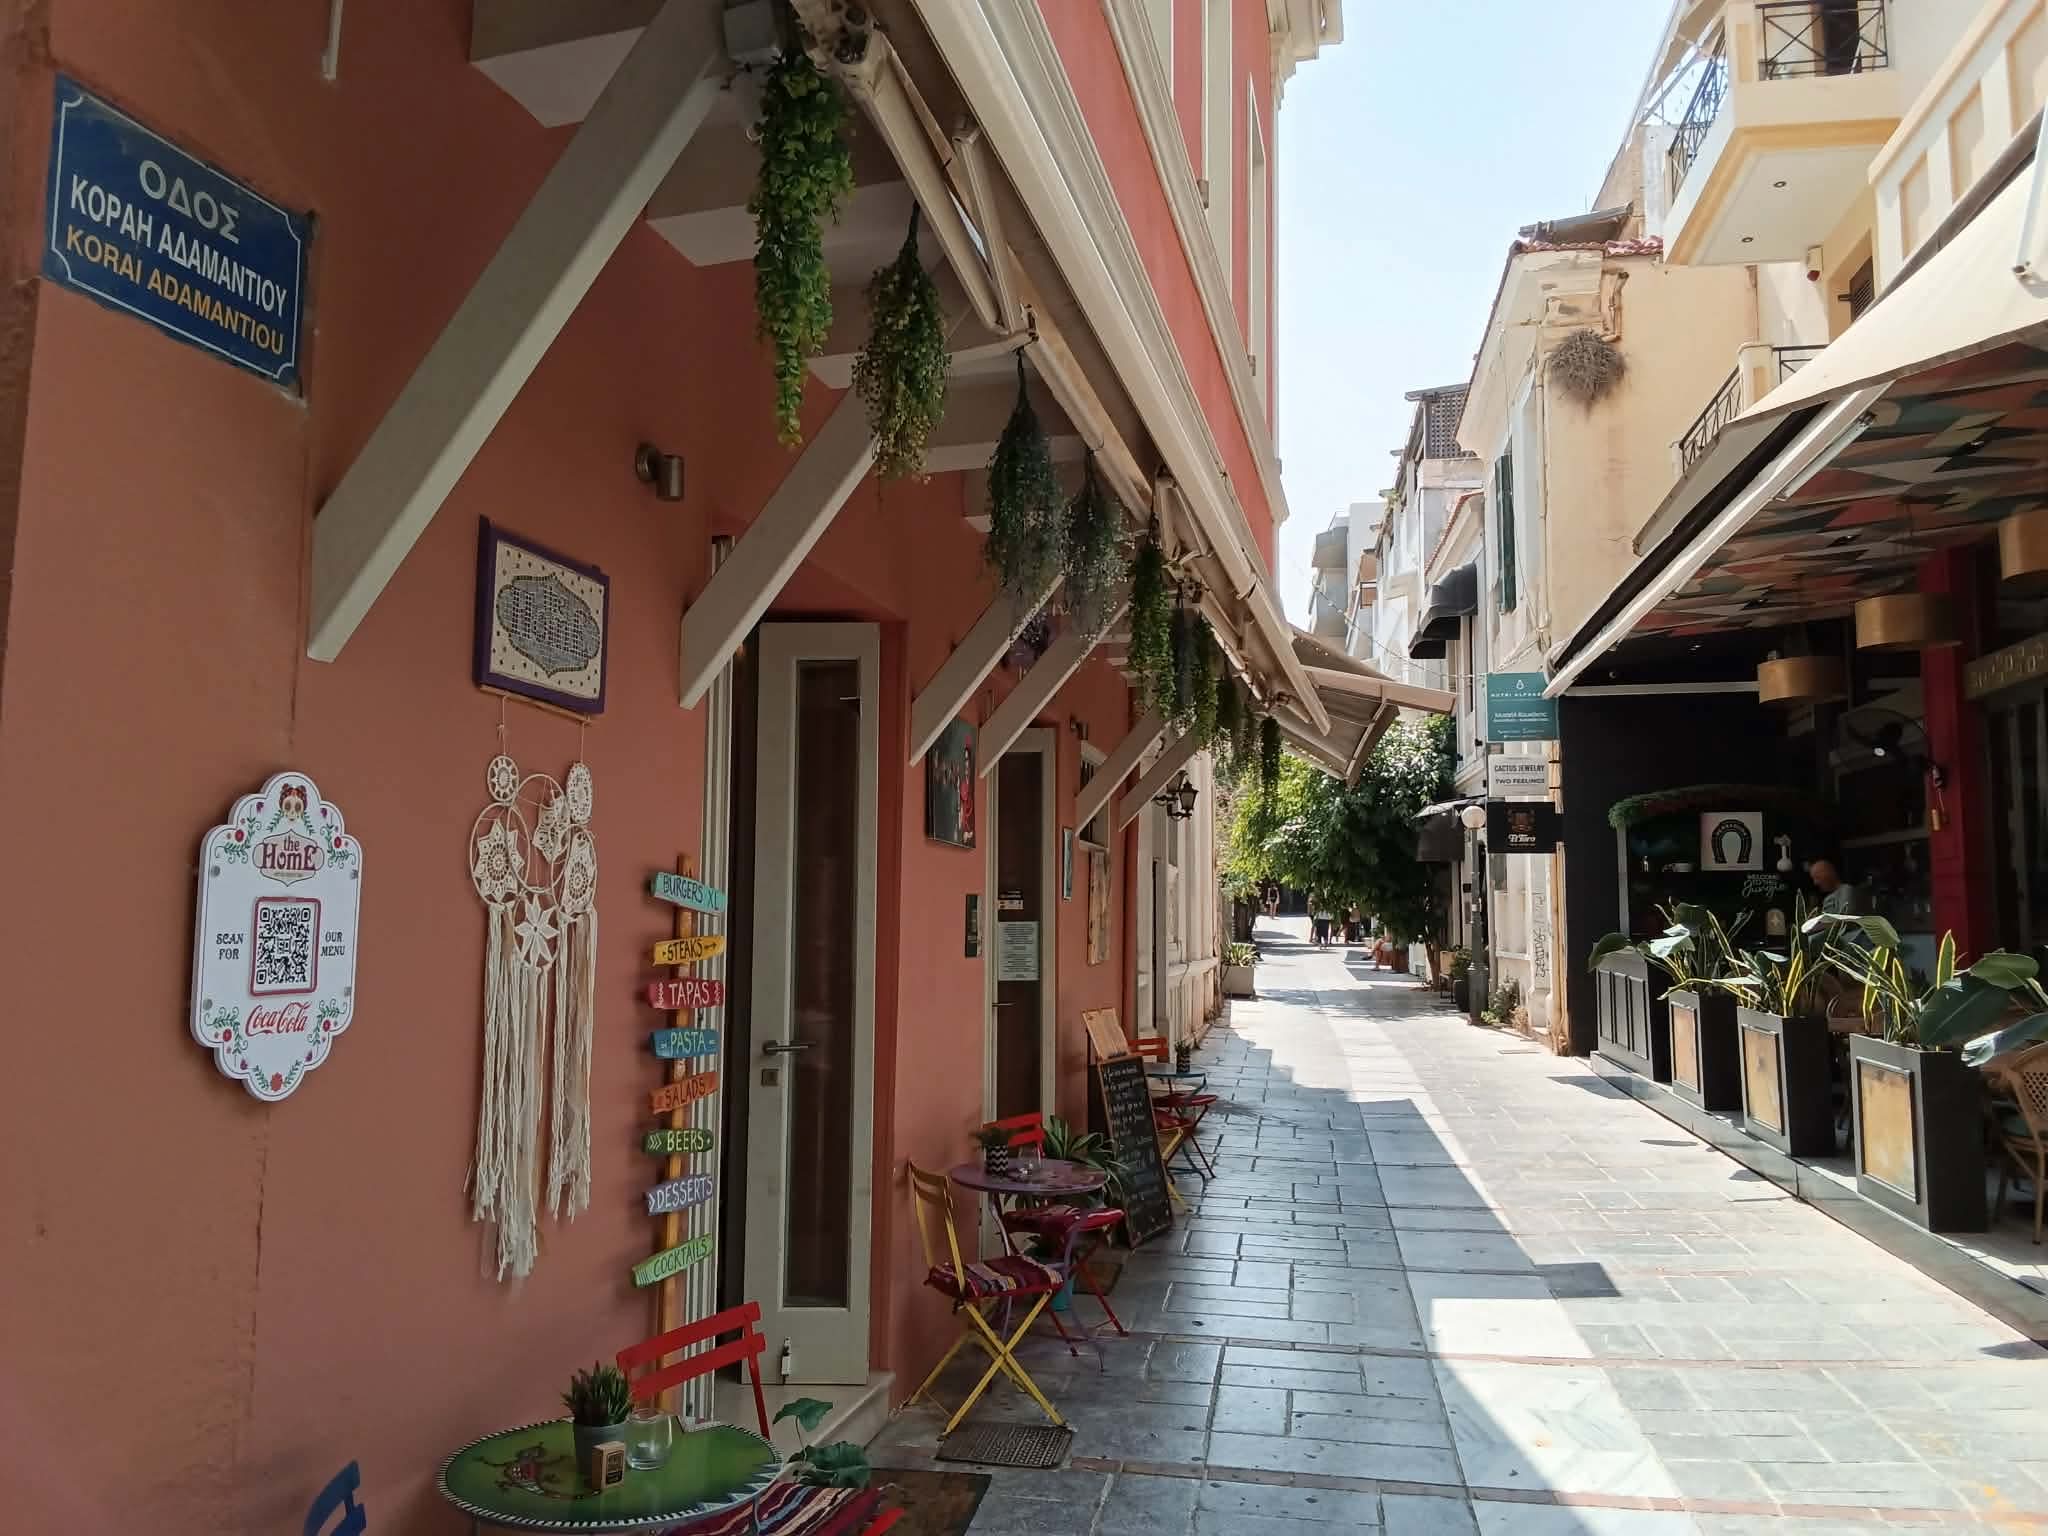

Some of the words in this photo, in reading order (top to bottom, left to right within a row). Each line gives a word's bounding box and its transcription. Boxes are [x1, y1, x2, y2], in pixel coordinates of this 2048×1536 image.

[139, 160, 240, 244] ΟΔΟΣ
[71, 174, 153, 248] ΚΟΡΑΗ
[158, 223, 287, 317] ΑΔΑΜΑΝΤΙΟΥ
[67, 224, 142, 284] KORAI
[147, 268, 284, 355] ADAMANTIOU
[283, 835, 300, 852] the
[663, 876, 703, 904] BURGERS
[706, 889, 720, 911] XL
[216, 932, 244, 946] SCAN
[325, 931, 343, 944] OUR
[667, 939, 703, 961] STEAKS
[219, 948, 239, 960] FOR
[321, 945, 346, 958] MENU
[668, 982, 710, 1006] TAPAS
[669, 1030, 707, 1056] PASTA
[665, 1078, 706, 1107] SALADS
[666, 1130, 704, 1151] BEERS
[656, 1175, 713, 1208] DESSERTS
[653, 1238, 708, 1278] COCKTAILS
